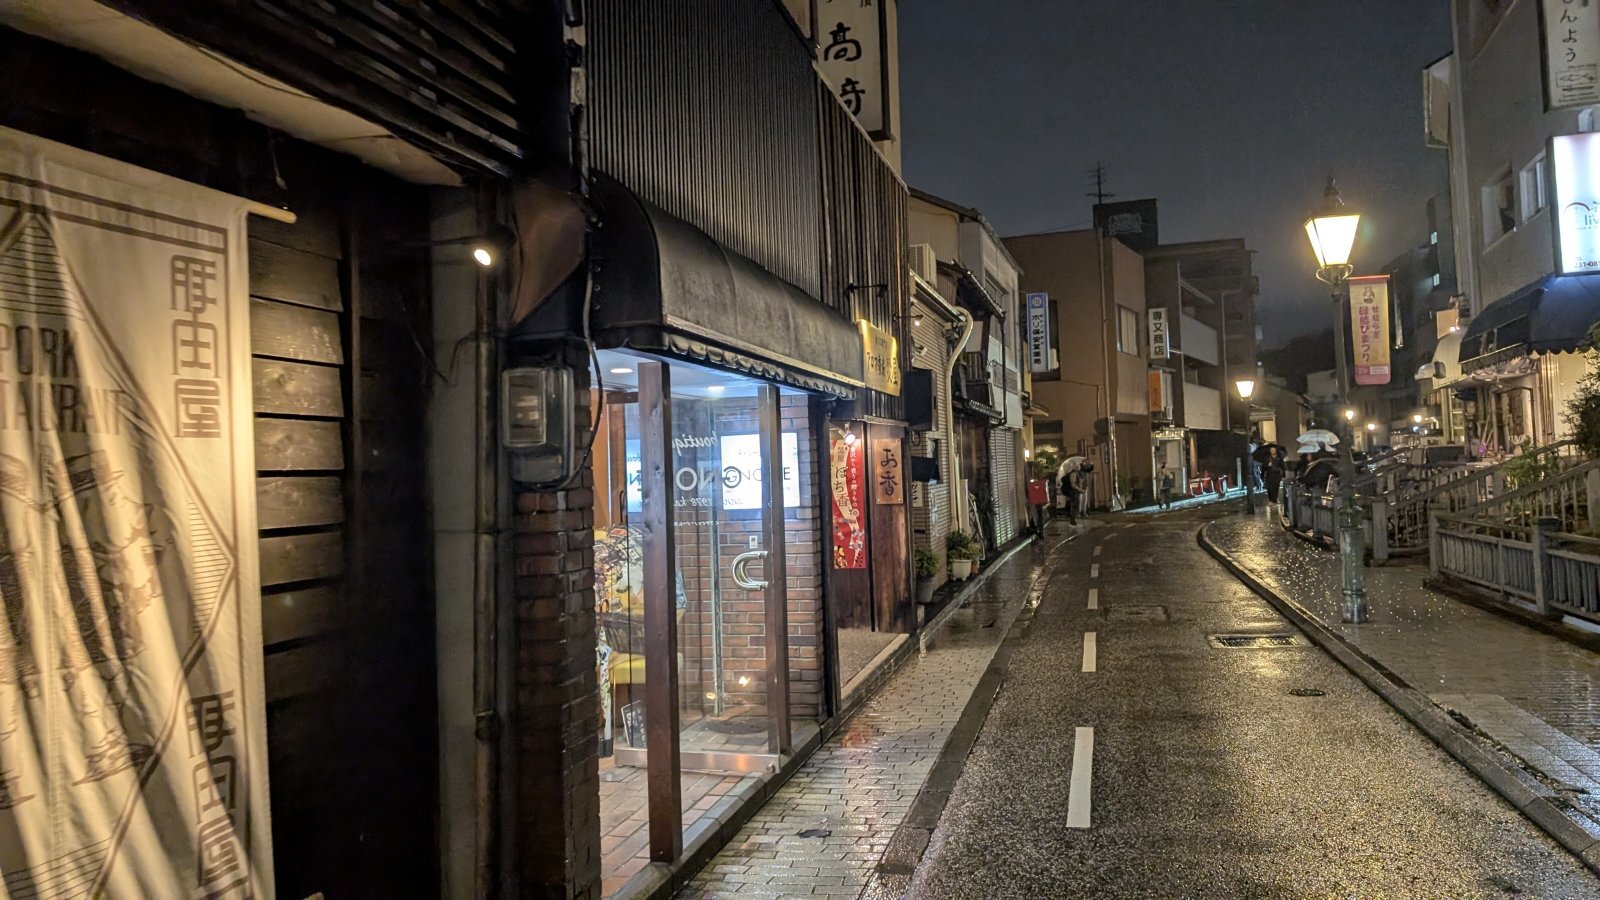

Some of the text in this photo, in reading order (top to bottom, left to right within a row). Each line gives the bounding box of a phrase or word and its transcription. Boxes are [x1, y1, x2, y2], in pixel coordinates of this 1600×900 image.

[1560, 0, 1578, 62] んよう
[880, 448, 898, 496] お香
